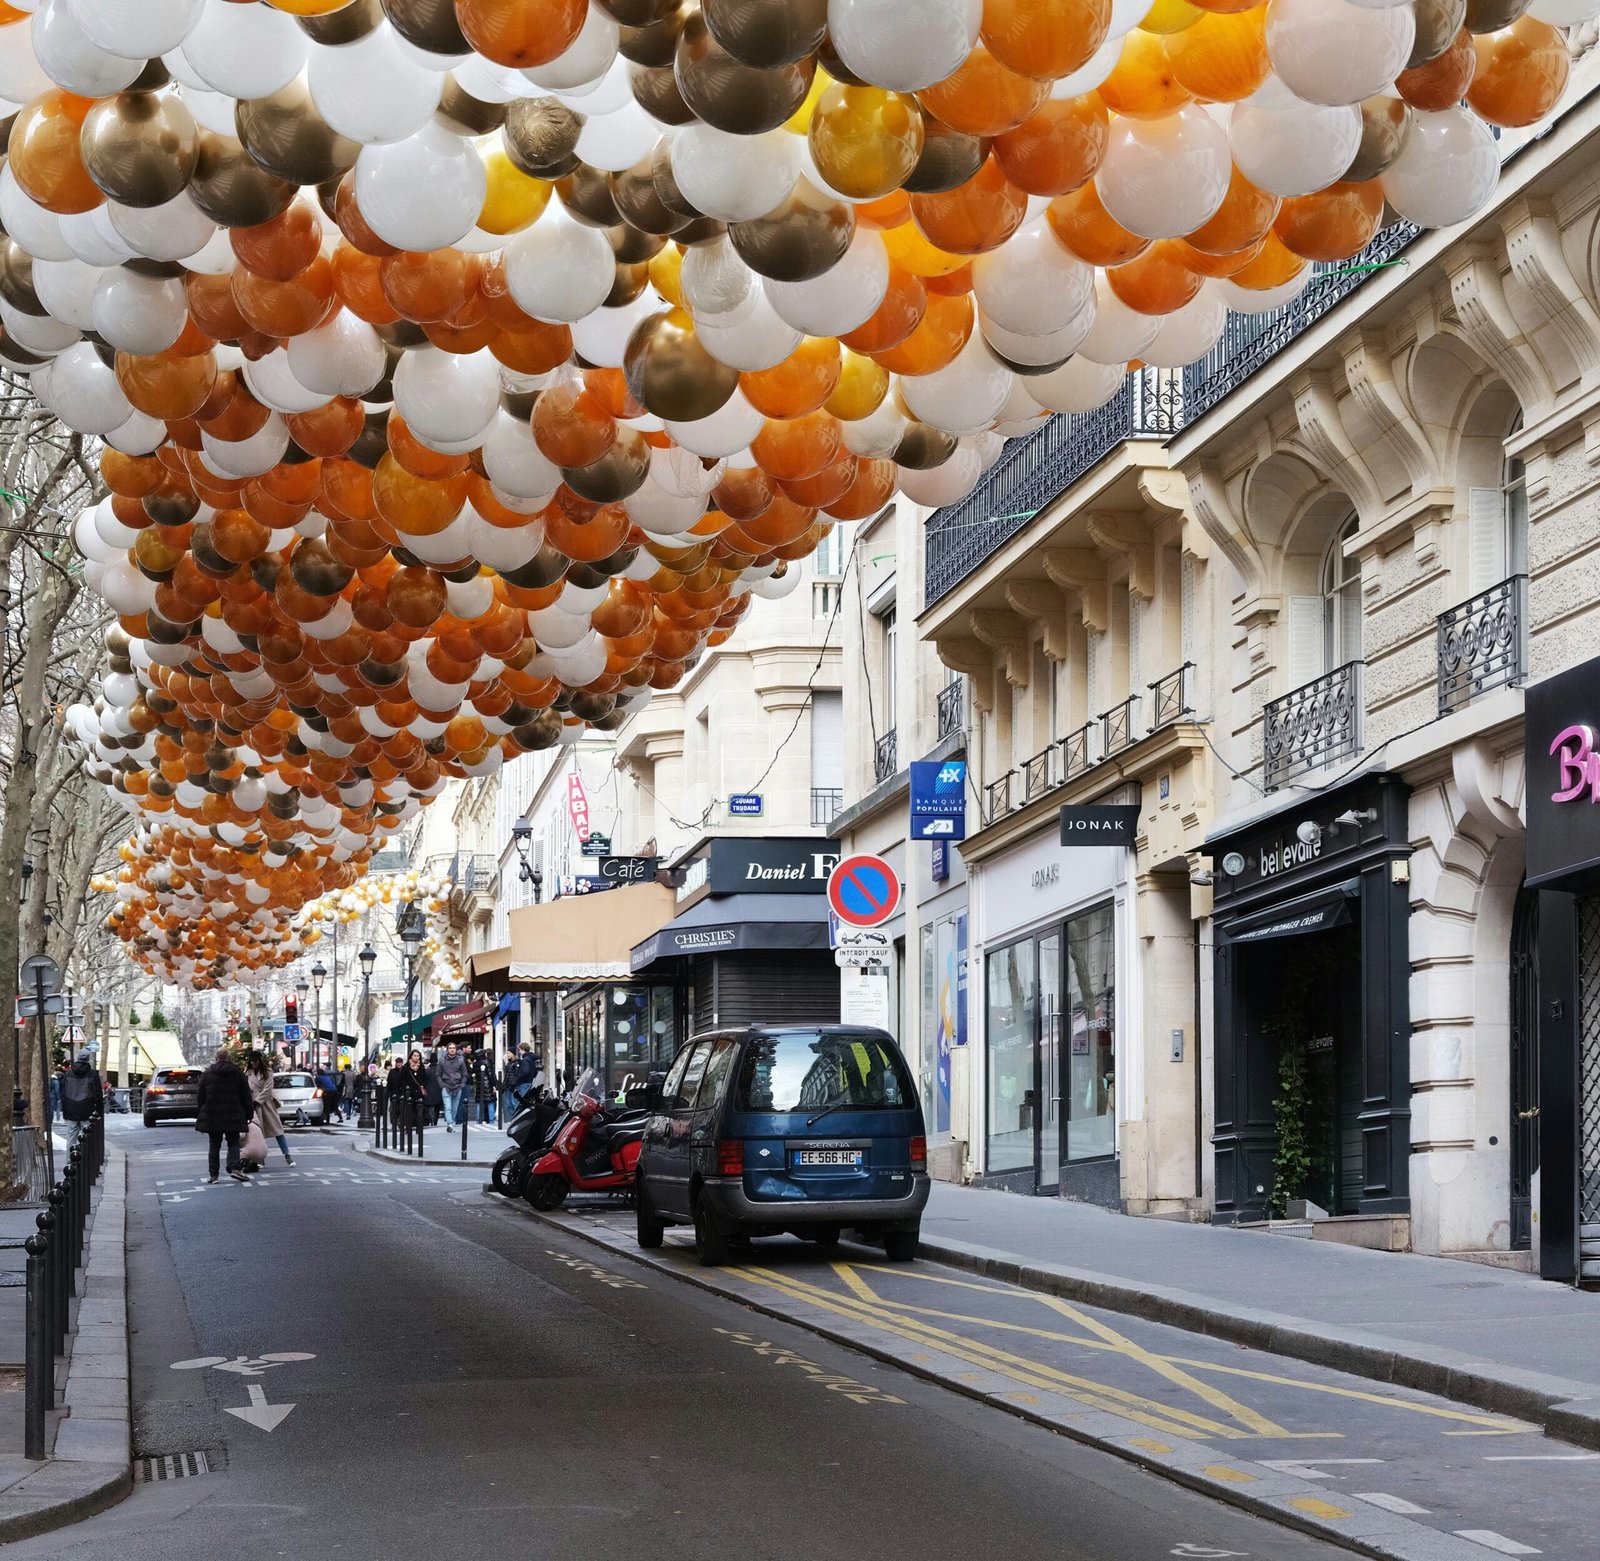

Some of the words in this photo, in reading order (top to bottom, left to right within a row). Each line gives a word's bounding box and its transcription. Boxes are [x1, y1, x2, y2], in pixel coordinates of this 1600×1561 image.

[568, 774, 589, 839] TABAC
[1068, 820, 1125, 830] JONAK
[602, 858, 645, 879] Café
[745, 862, 807, 880] Daniel
[1269, 919, 1300, 934] FROMAGER
[674, 929, 736, 945] CHRISTIE'S
[680, 941, 709, 949] INTERNATIONAL
[572, 966, 617, 975] BRASSERIE
[801, 1151, 856, 1164] EE-566-HC
[712, 1326, 909, 1405] LIVRAISON
